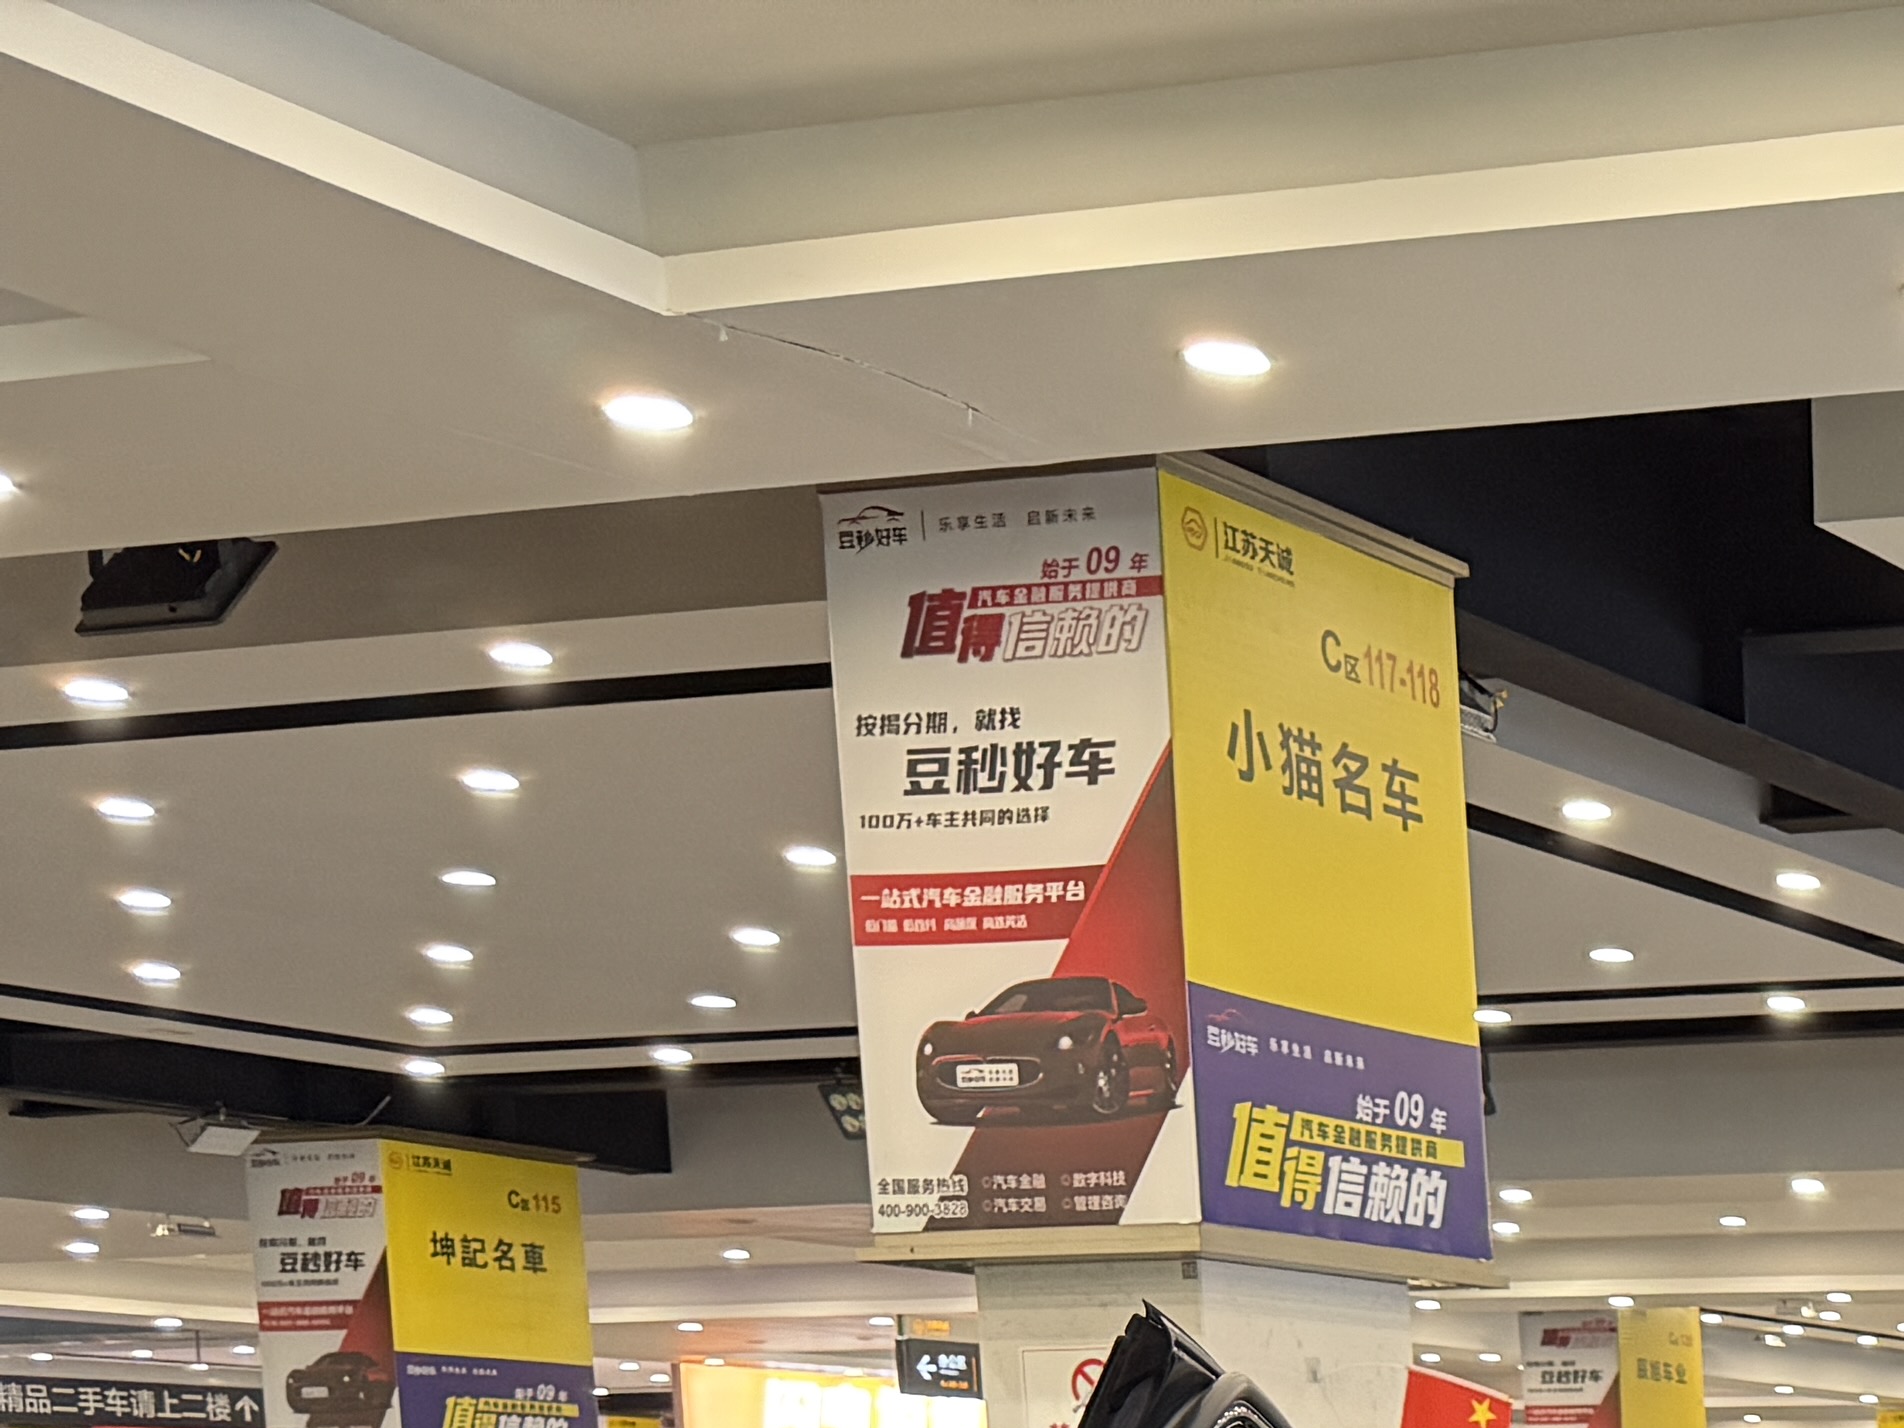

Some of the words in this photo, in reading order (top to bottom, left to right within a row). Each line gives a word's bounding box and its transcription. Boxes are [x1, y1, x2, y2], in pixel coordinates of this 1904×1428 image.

[1041, 557, 1079, 580] 始于
[1086, 545, 1120, 575] 09
[1129, 553, 1149, 573] 年
[901, 588, 1149, 663] 值得信赖的
[903, 738, 1116, 796] 豆秒好车
[1227, 708, 1424, 832] 小猫名车
[859, 805, 1050, 830] 100万+车主共同的选择
[861, 880, 1086, 910] 一站式汽车金融服务平台
[1356, 1094, 1390, 1124] 始于
[1394, 1091, 1424, 1128] 09
[1430, 1108, 1448, 1135] 年
[877, 1176, 968, 1196] 全国服务热线
[993, 1174, 1046, 1190] 汽车金融
[1225, 1101, 1447, 1229] 值得信赖的
[430, 1230, 548, 1274] 坤記名車
[0, 1382, 231, 1422] 精品二手车请上二楼
